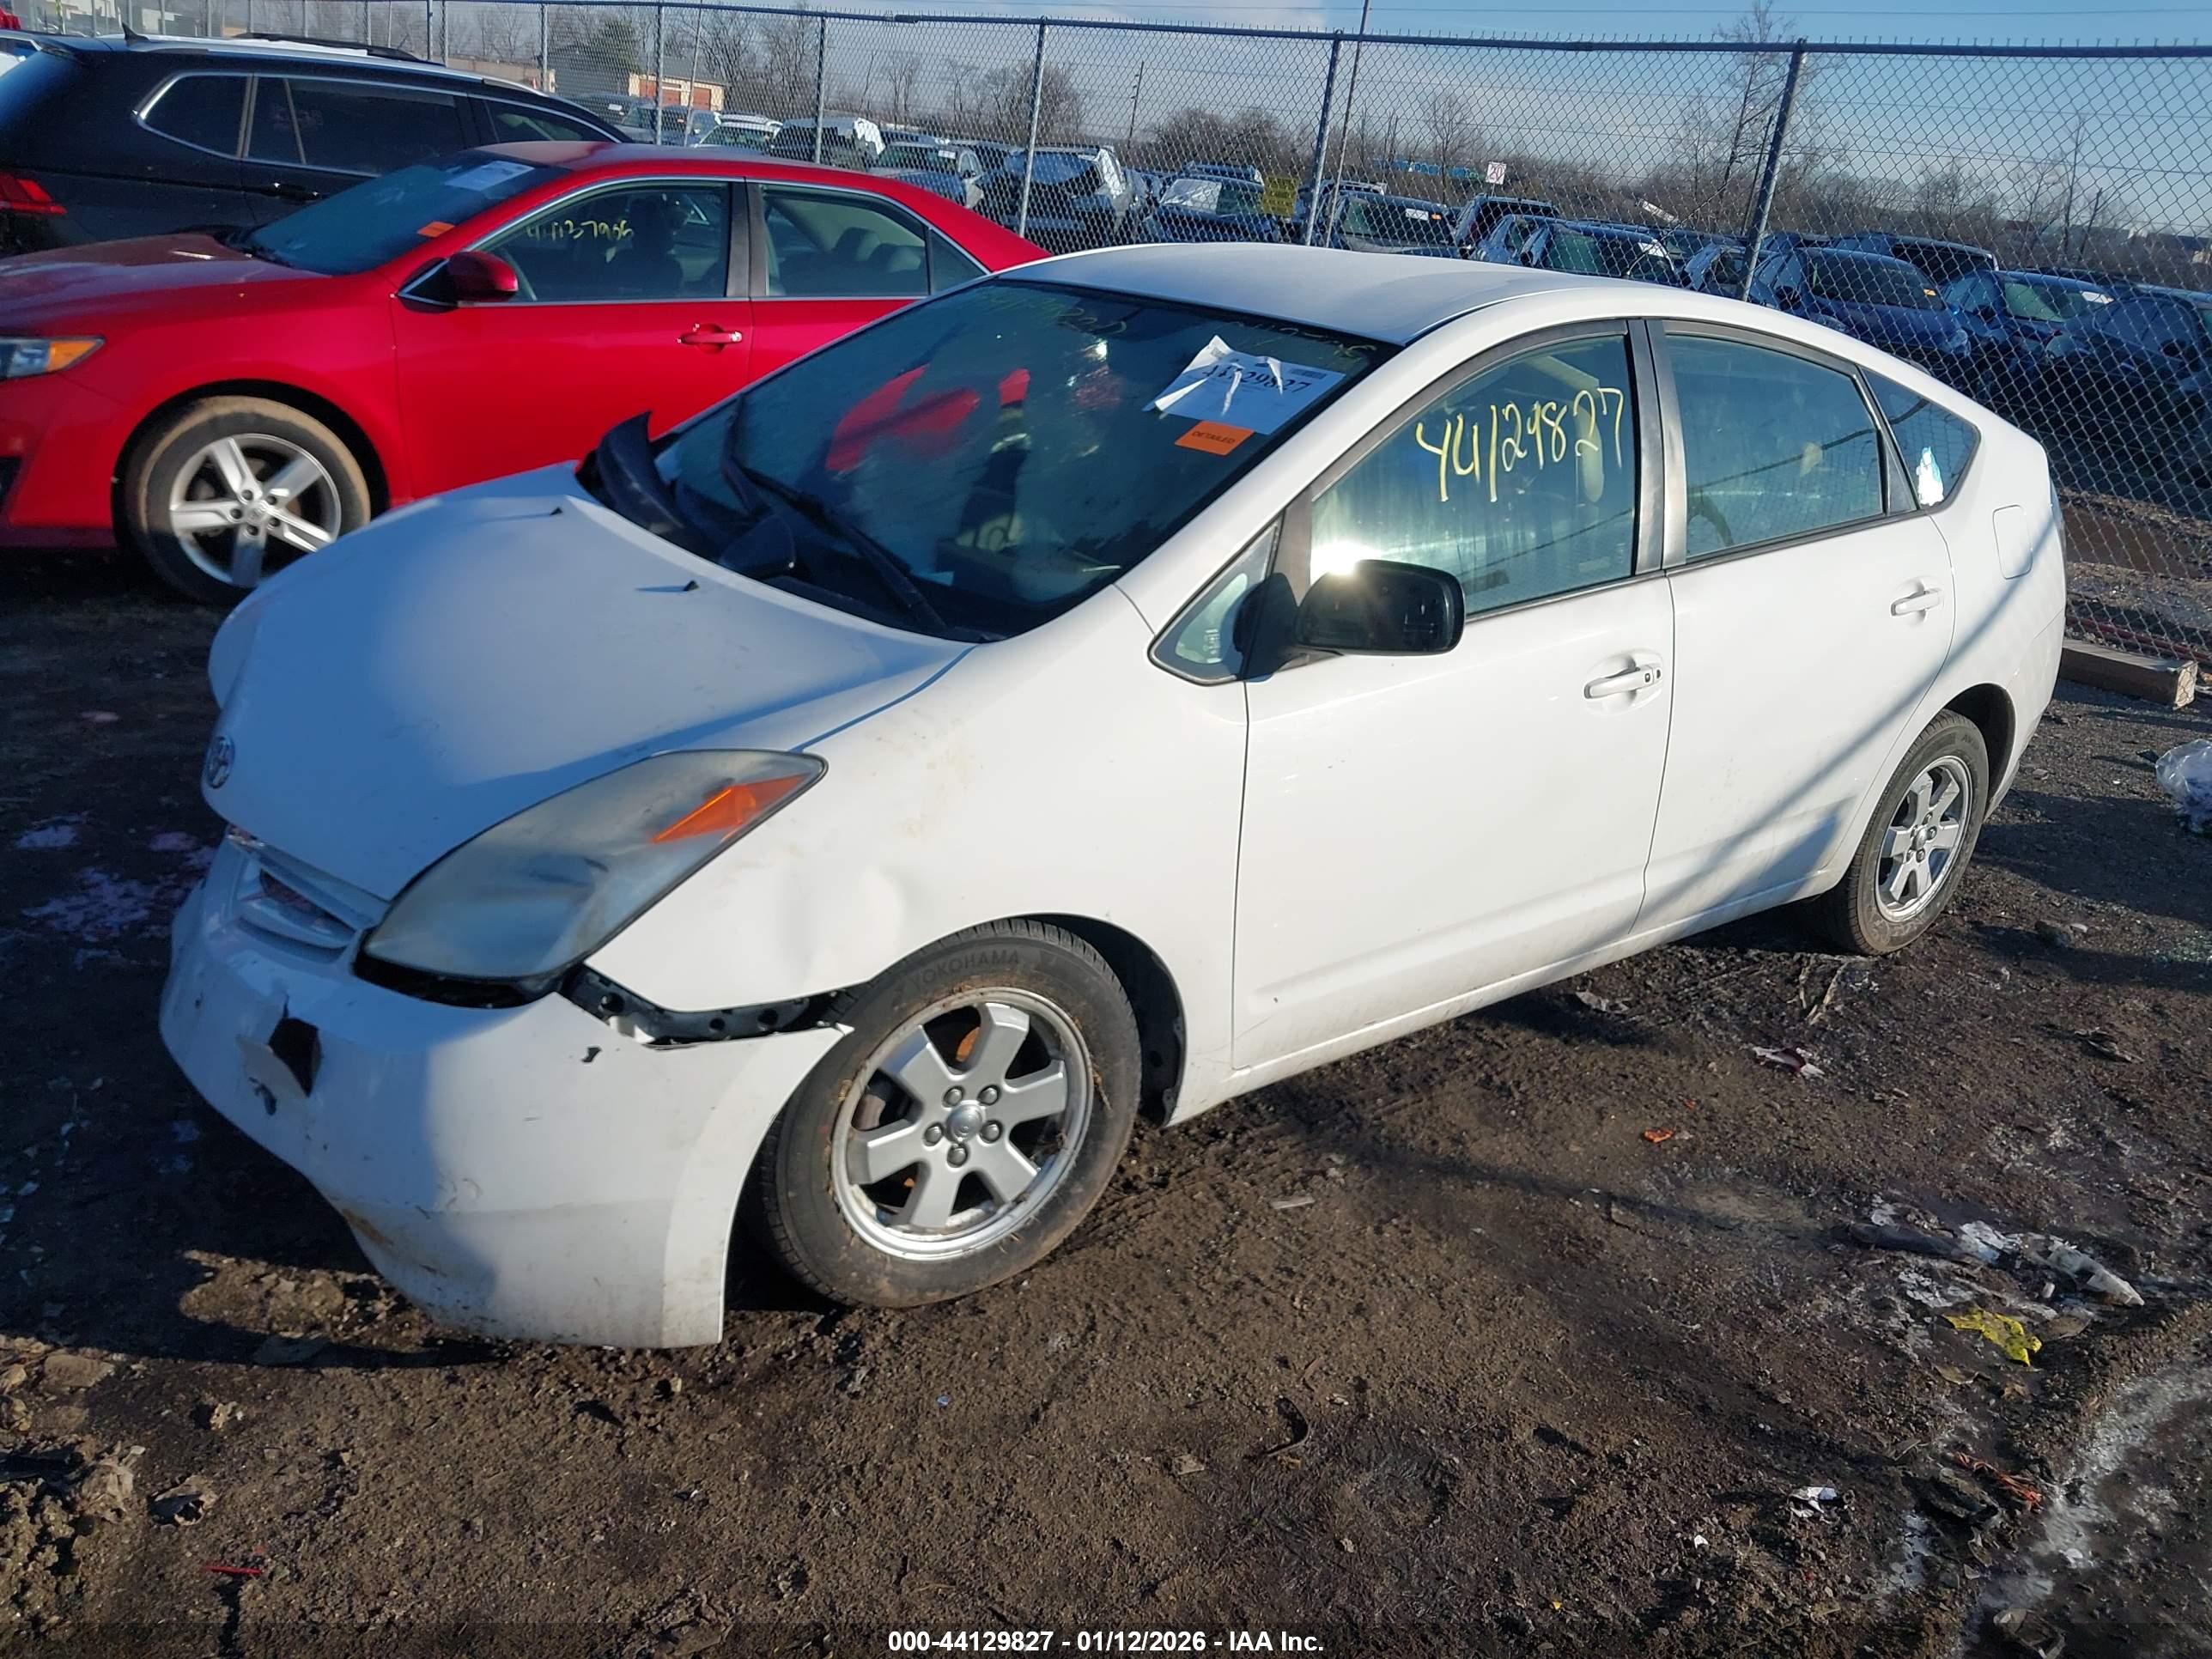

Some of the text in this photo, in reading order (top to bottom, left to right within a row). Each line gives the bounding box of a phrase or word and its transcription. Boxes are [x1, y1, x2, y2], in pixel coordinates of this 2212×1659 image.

[1191, 430, 1237, 445] DETAILED
[1415, 387, 1625, 503] 44129827
[909, 949, 1019, 988] YOKOHAMA
